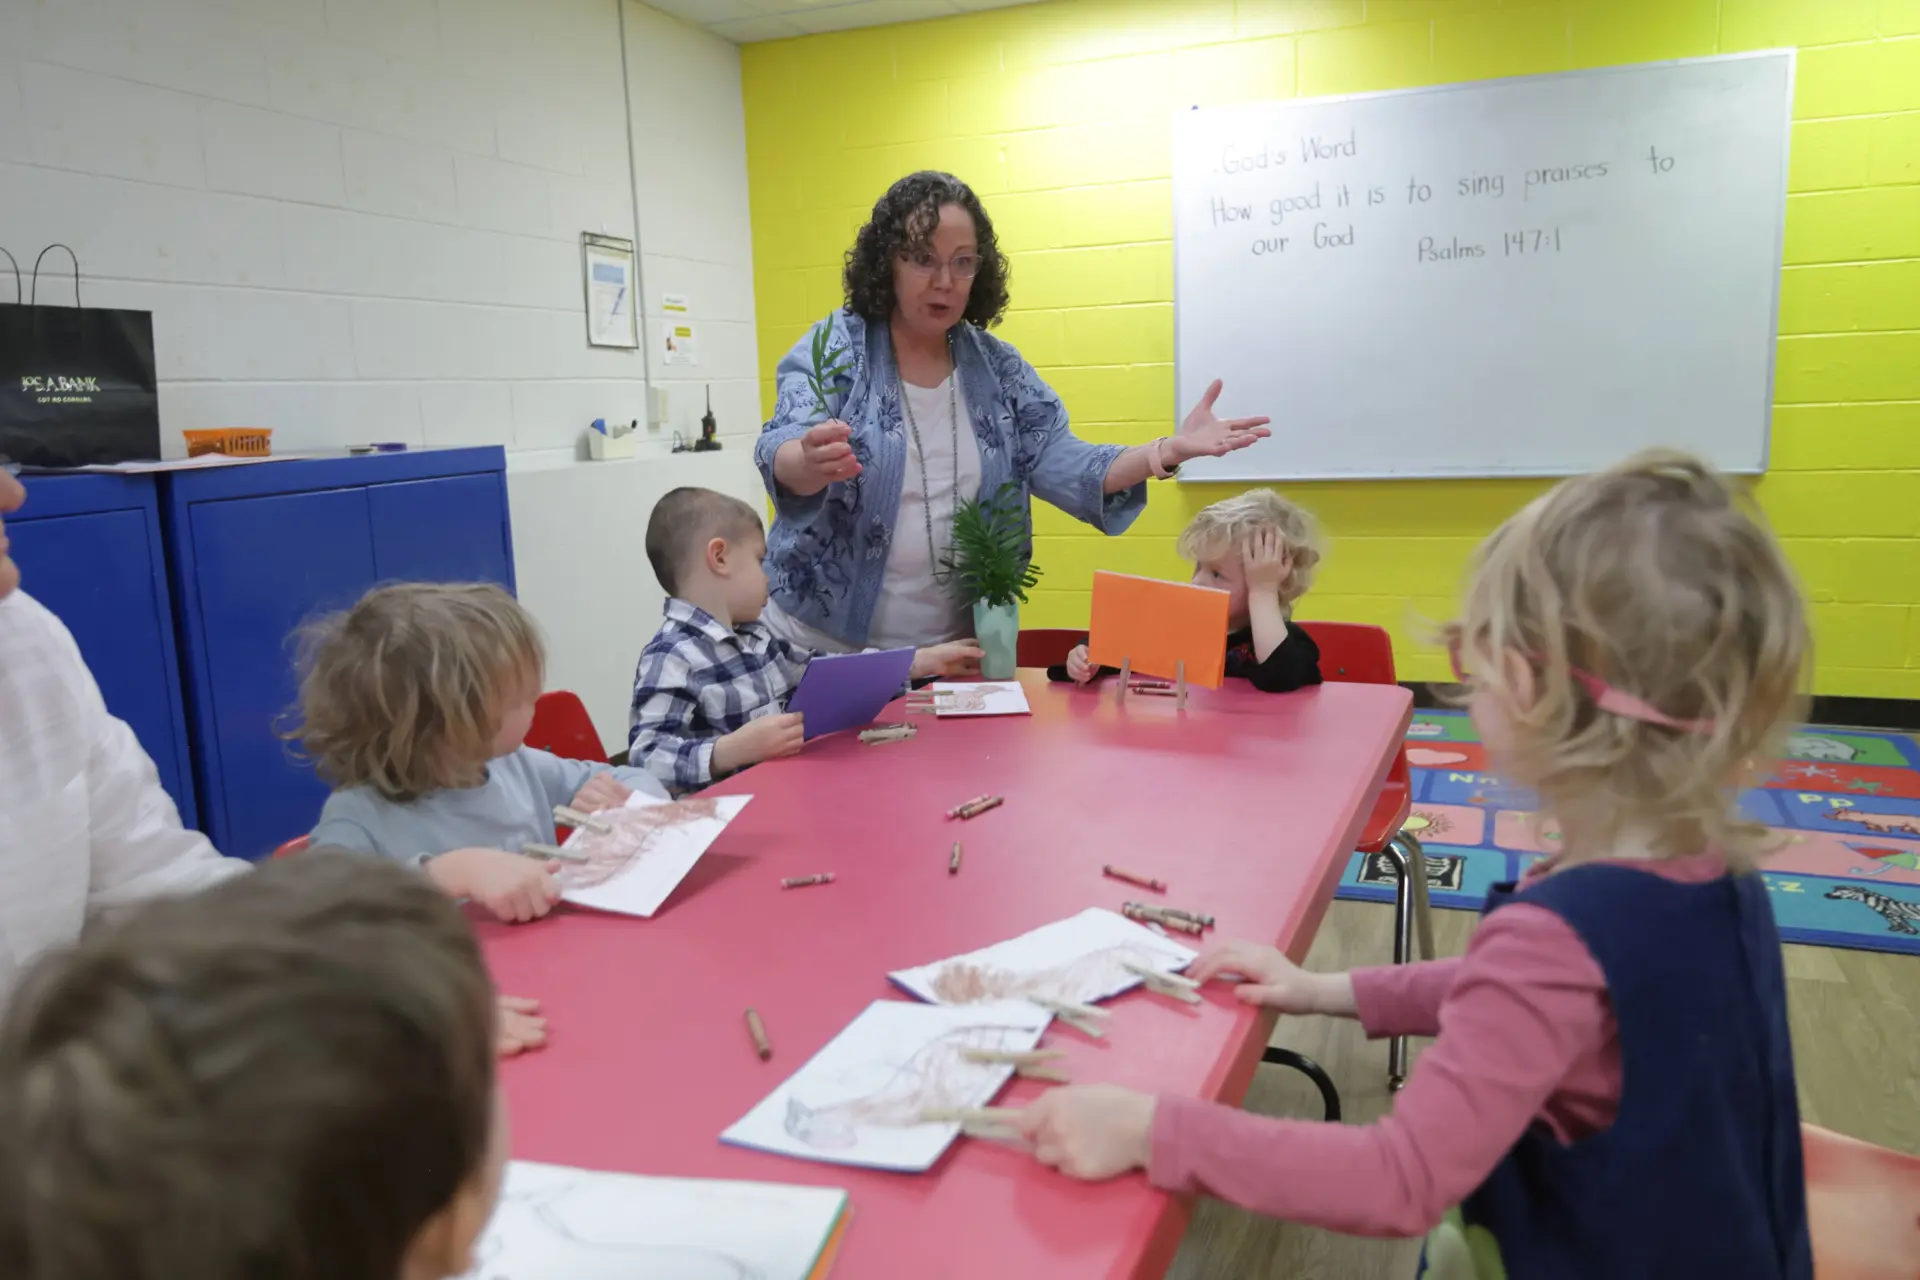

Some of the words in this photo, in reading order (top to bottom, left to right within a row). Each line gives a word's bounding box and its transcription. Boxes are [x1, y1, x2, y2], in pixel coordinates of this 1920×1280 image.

[1301, 127, 1356, 163] Word
[1211, 195, 1251, 228] How
[1270, 180, 1320, 226] good
[1336, 183, 1350, 208] it
[1367, 183, 1386, 206] is
[1406, 175, 1432, 205] to
[1458, 171, 1504, 198] sing
[1524, 162, 1608, 202] praises
[1646, 145, 1675, 174] to
[1251, 236, 1289, 256] our
[1313, 222, 1354, 249] God
[1418, 236, 1486, 263] Psalms
[1504, 226, 1560, 256] 147:1
